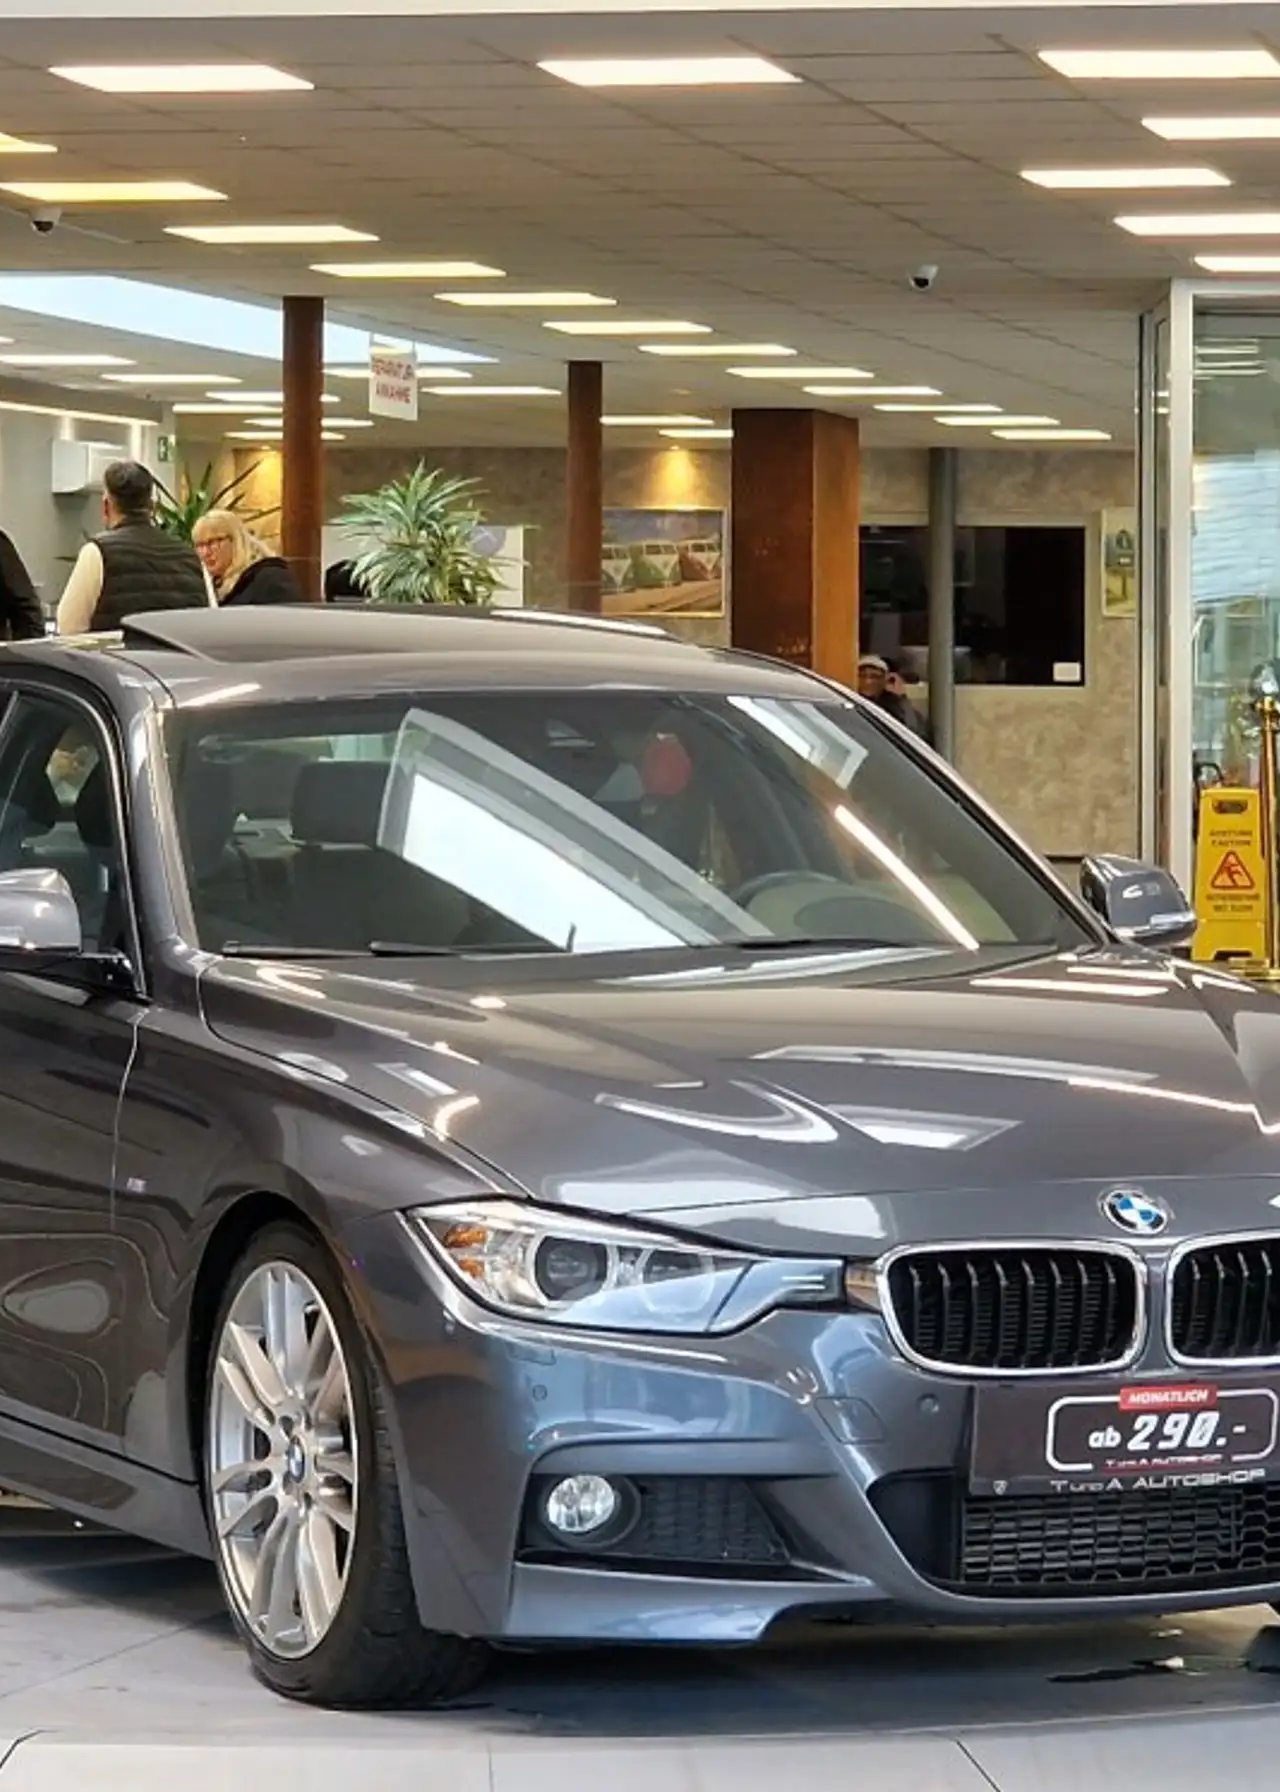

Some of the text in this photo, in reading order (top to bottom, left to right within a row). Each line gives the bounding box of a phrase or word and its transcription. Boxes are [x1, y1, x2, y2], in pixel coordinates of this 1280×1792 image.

[1127, 1389, 1209, 1404] MONATLICH
[1088, 1426, 1122, 1448] ab
[1132, 1468, 1266, 1490] AUTOSHOP
